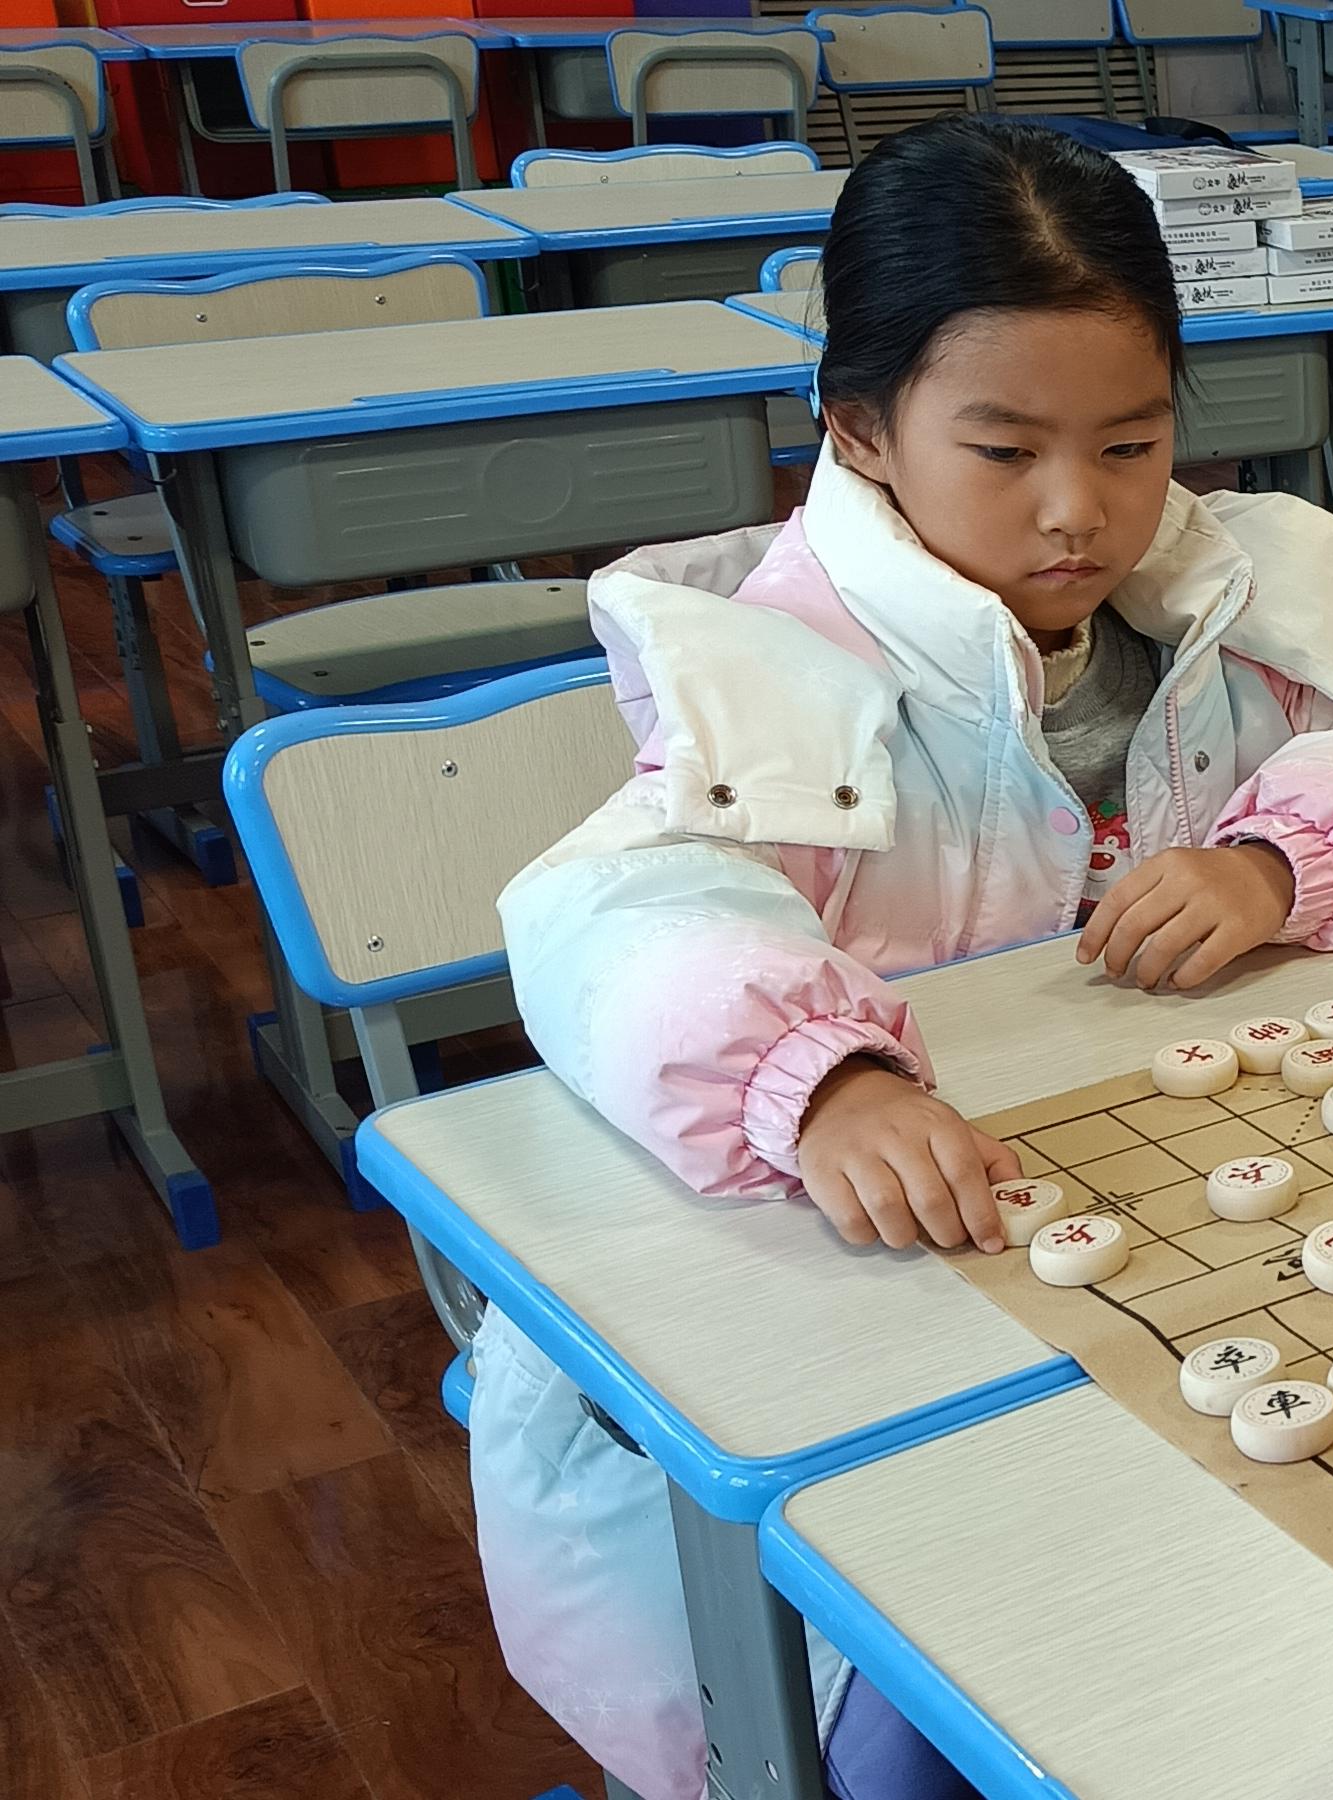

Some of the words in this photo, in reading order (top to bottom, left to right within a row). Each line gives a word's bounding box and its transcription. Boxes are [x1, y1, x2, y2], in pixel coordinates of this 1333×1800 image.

[1228, 1163, 1272, 1184] 兵
[1051, 1223, 1095, 1245] 兵
[1210, 1345, 1255, 1372] 卒
[1261, 1390, 1311, 1418] 車
